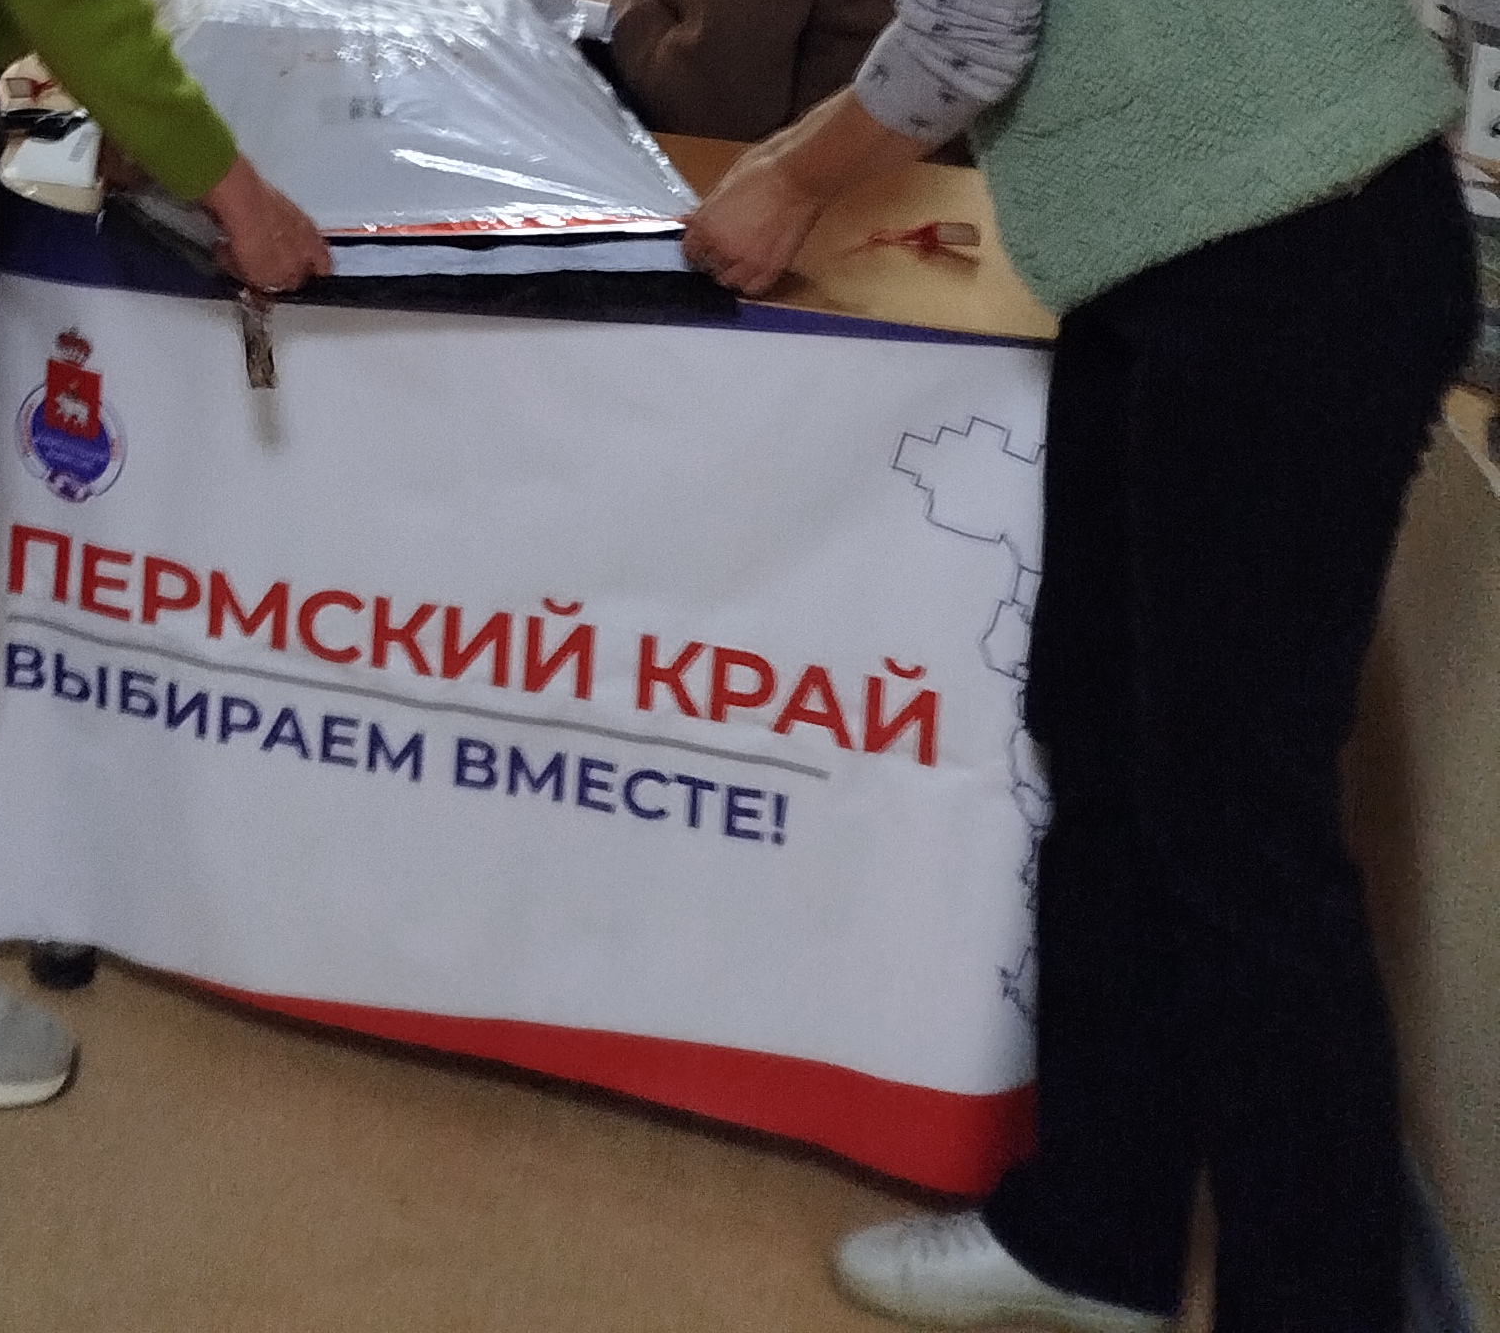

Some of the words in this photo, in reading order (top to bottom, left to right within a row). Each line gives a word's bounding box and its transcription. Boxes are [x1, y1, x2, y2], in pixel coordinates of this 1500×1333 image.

[4, 641, 424, 783] ВЫБИРАЕМ
[453, 736, 790, 846] ВМЕСТЕ!
[5, 524, 595, 701] ПЕРМСКИЙ
[636, 632, 944, 768] КРАЙ
